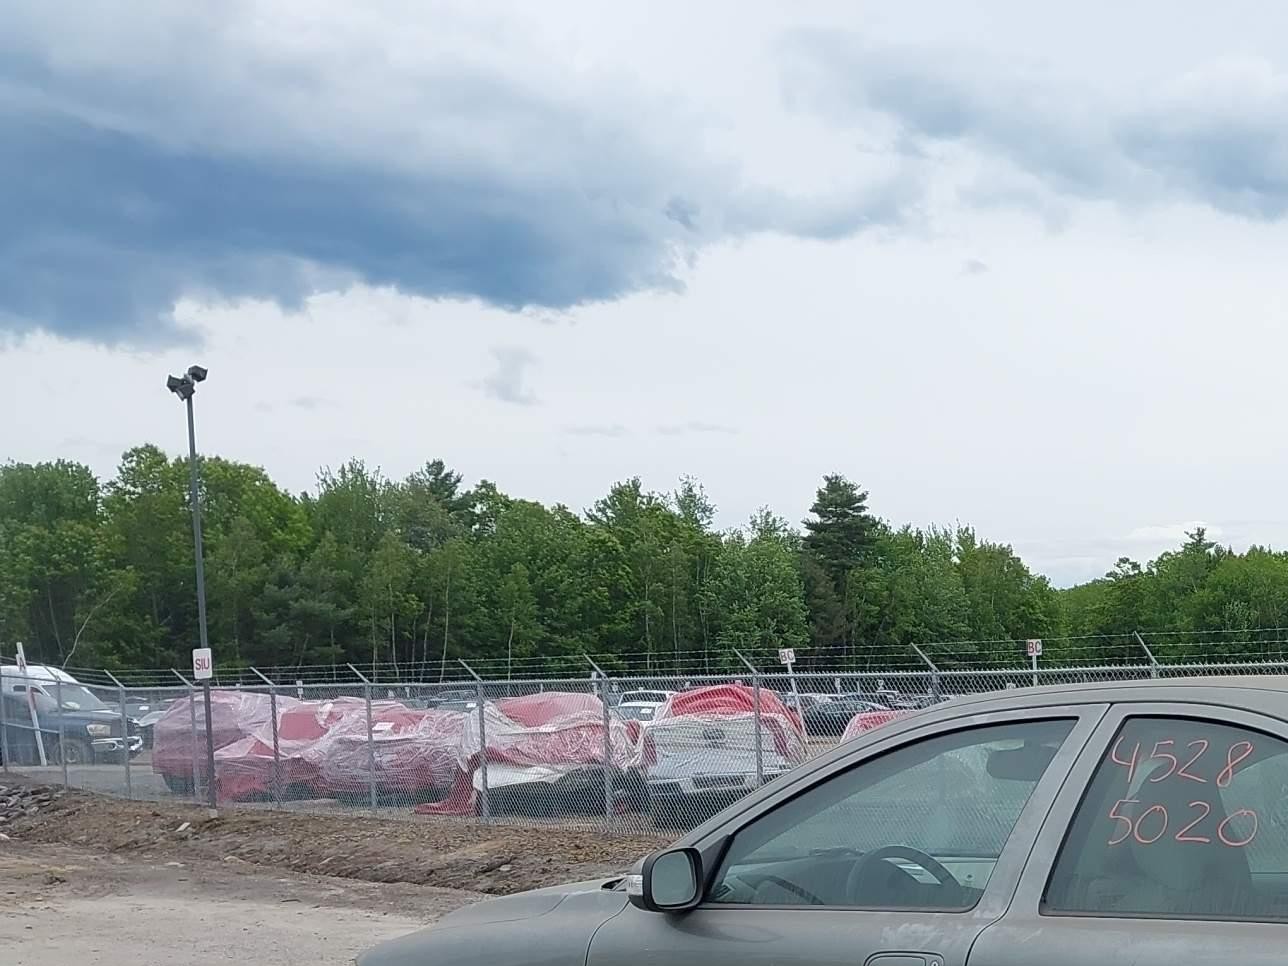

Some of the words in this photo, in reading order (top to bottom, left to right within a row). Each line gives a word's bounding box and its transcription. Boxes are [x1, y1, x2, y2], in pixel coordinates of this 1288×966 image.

[1028, 640, 1042, 654] BC
[195, 656, 210, 671] SIU
[779, 650, 794, 662] BC
[1111, 736, 1254, 788] 4528
[1108, 799, 1259, 847] 5020
